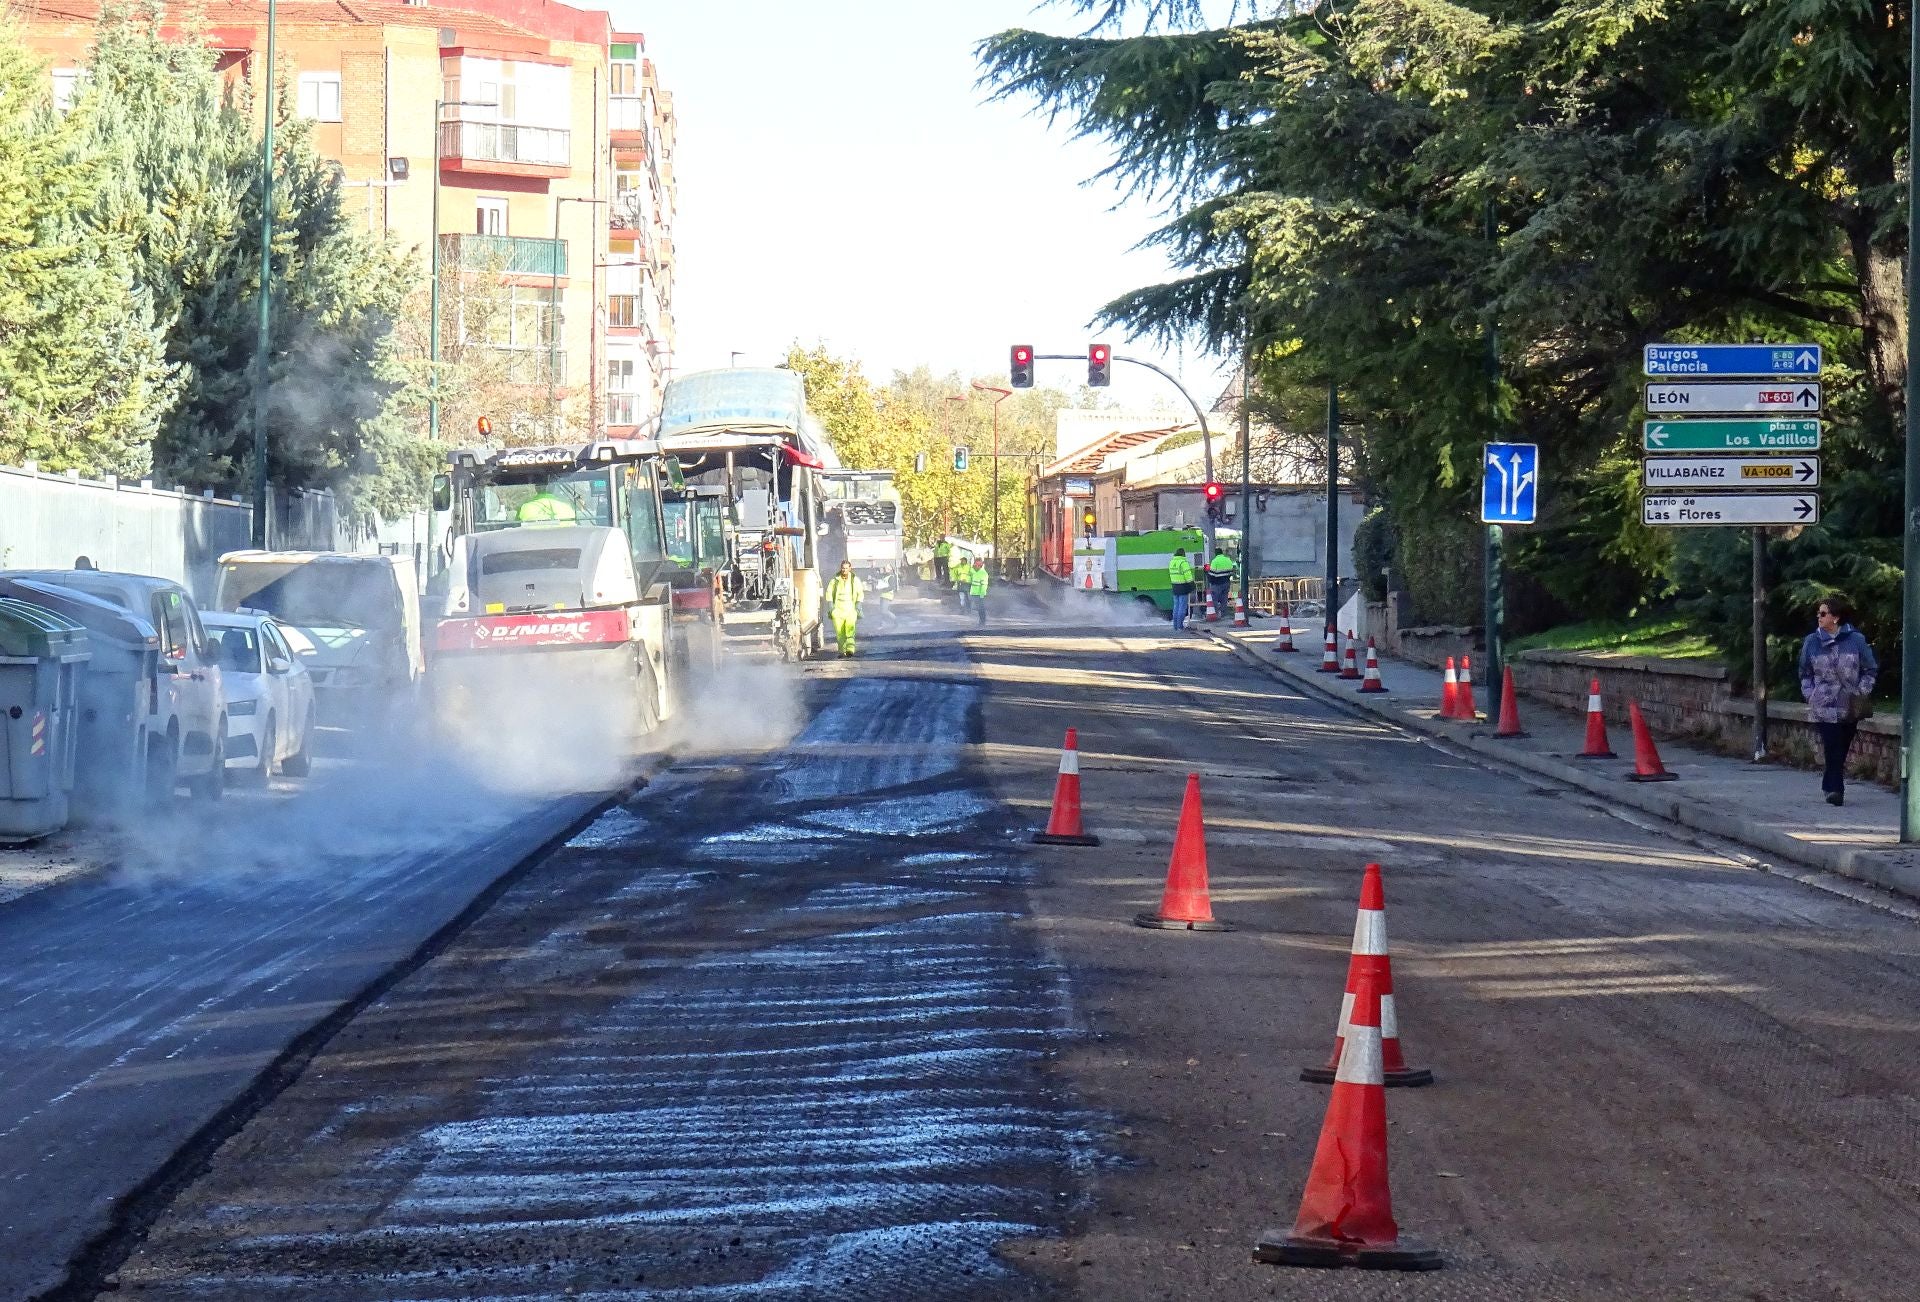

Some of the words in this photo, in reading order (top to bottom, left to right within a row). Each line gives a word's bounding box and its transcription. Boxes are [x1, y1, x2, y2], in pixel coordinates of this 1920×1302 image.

[1649, 349, 1699, 361] Burgos
[1649, 361, 1708, 372] Palencia
[1649, 391, 1690, 404] LEÓN
[1759, 393, 1793, 403] N-601
[1769, 422, 1797, 432] plaza
[1803, 422, 1816, 430] de
[1725, 434, 1750, 445] Los
[1759, 433, 1816, 445] Vadillos
[1648, 466, 1725, 478] VILLABAÑEZ
[1743, 467, 1791, 477] VA-1004
[1647, 498, 1677, 506] barrio
[1683, 498, 1695, 506] de
[1647, 510, 1670, 520] Las
[1679, 509, 1721, 520] Flores
[492, 621, 591, 637] DYNAPAC
